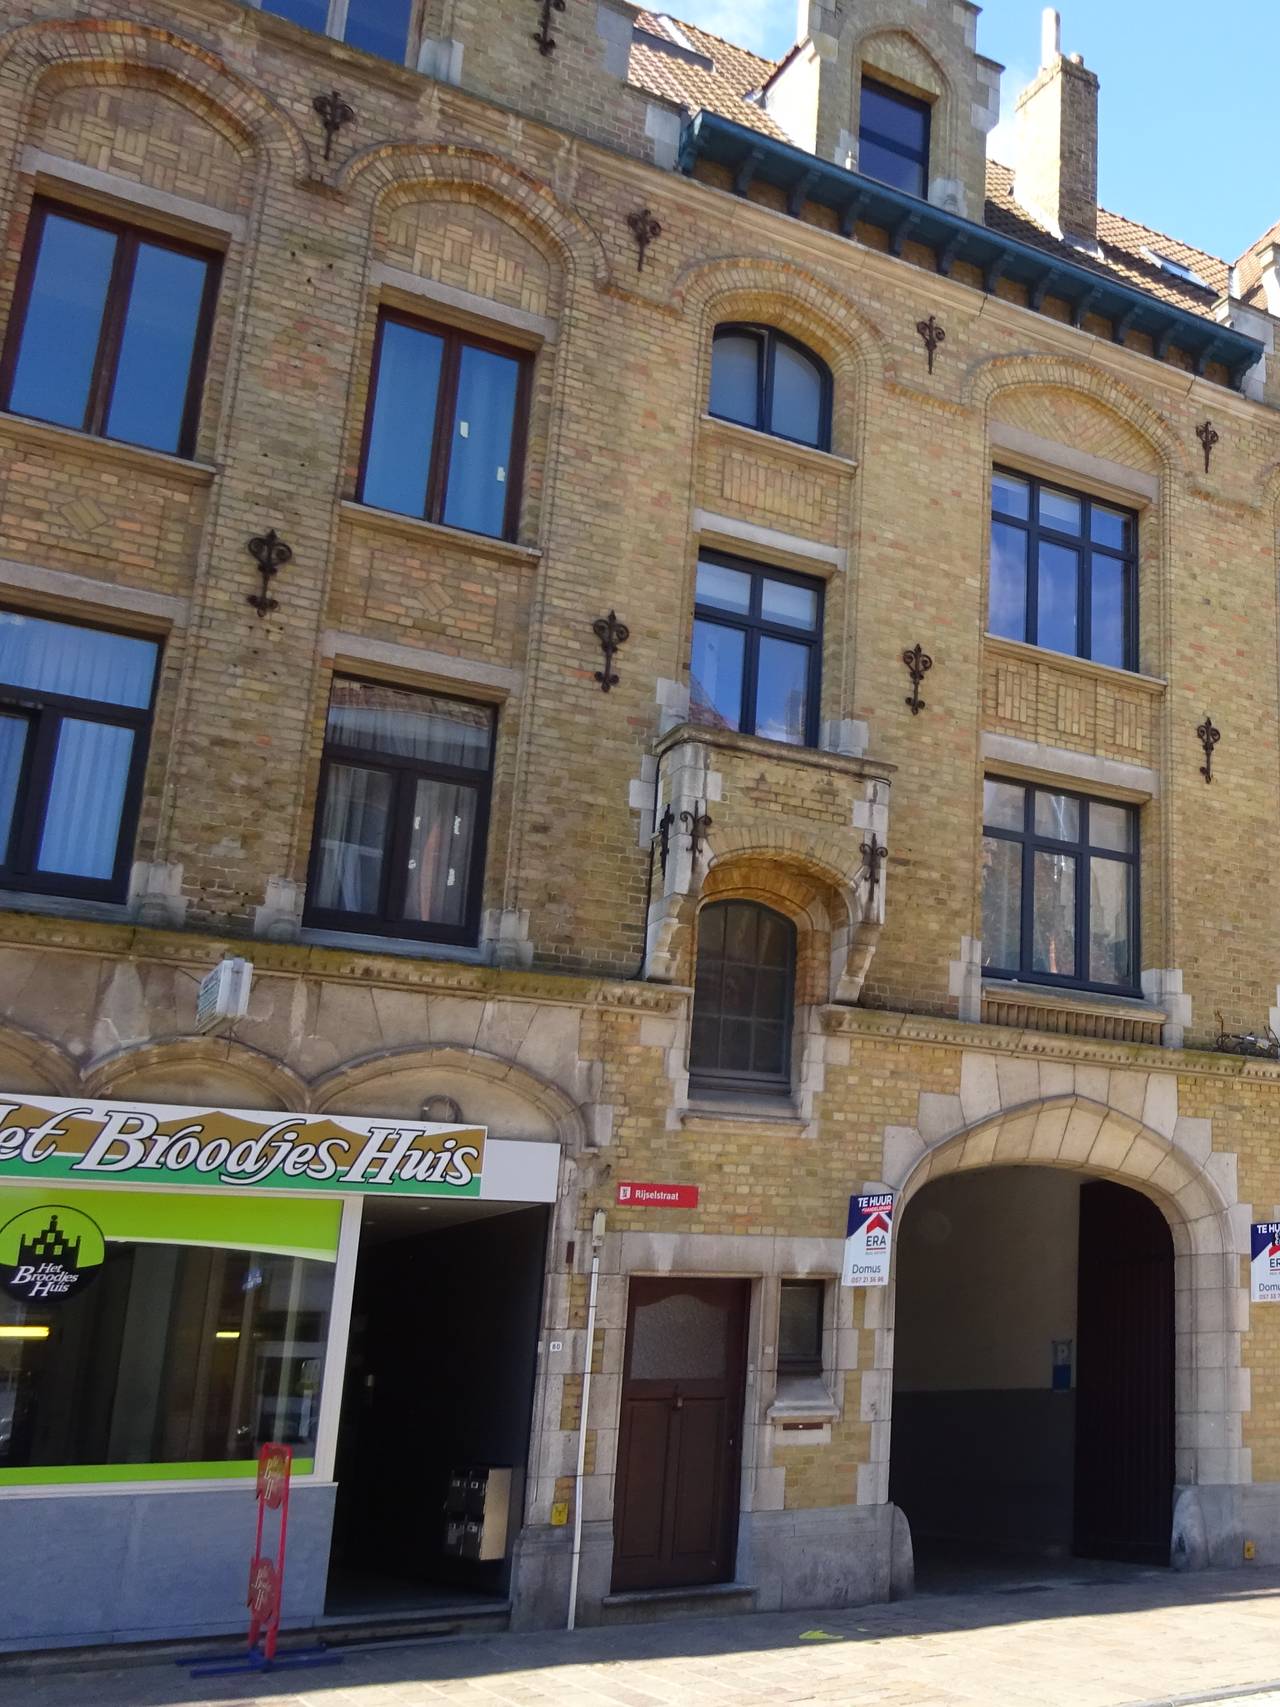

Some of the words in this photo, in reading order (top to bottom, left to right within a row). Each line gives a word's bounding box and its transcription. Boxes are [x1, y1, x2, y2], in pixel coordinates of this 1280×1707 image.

[69, 1110, 351, 1185] Broodjes
[337, 1126, 479, 1186] Huis
[635, 1189, 679, 1200] Rijselstraat
[858, 1197, 869, 1207] TE
[869, 1195, 893, 1207] HUUR
[1256, 1224, 1267, 1234] TE
[866, 1234, 887, 1247] ERA
[37, 1262, 64, 1274] Het
[852, 1264, 881, 1274] Domus
[10, 1265, 79, 1284] Broodjes
[28, 1281, 71, 1297] Huis
